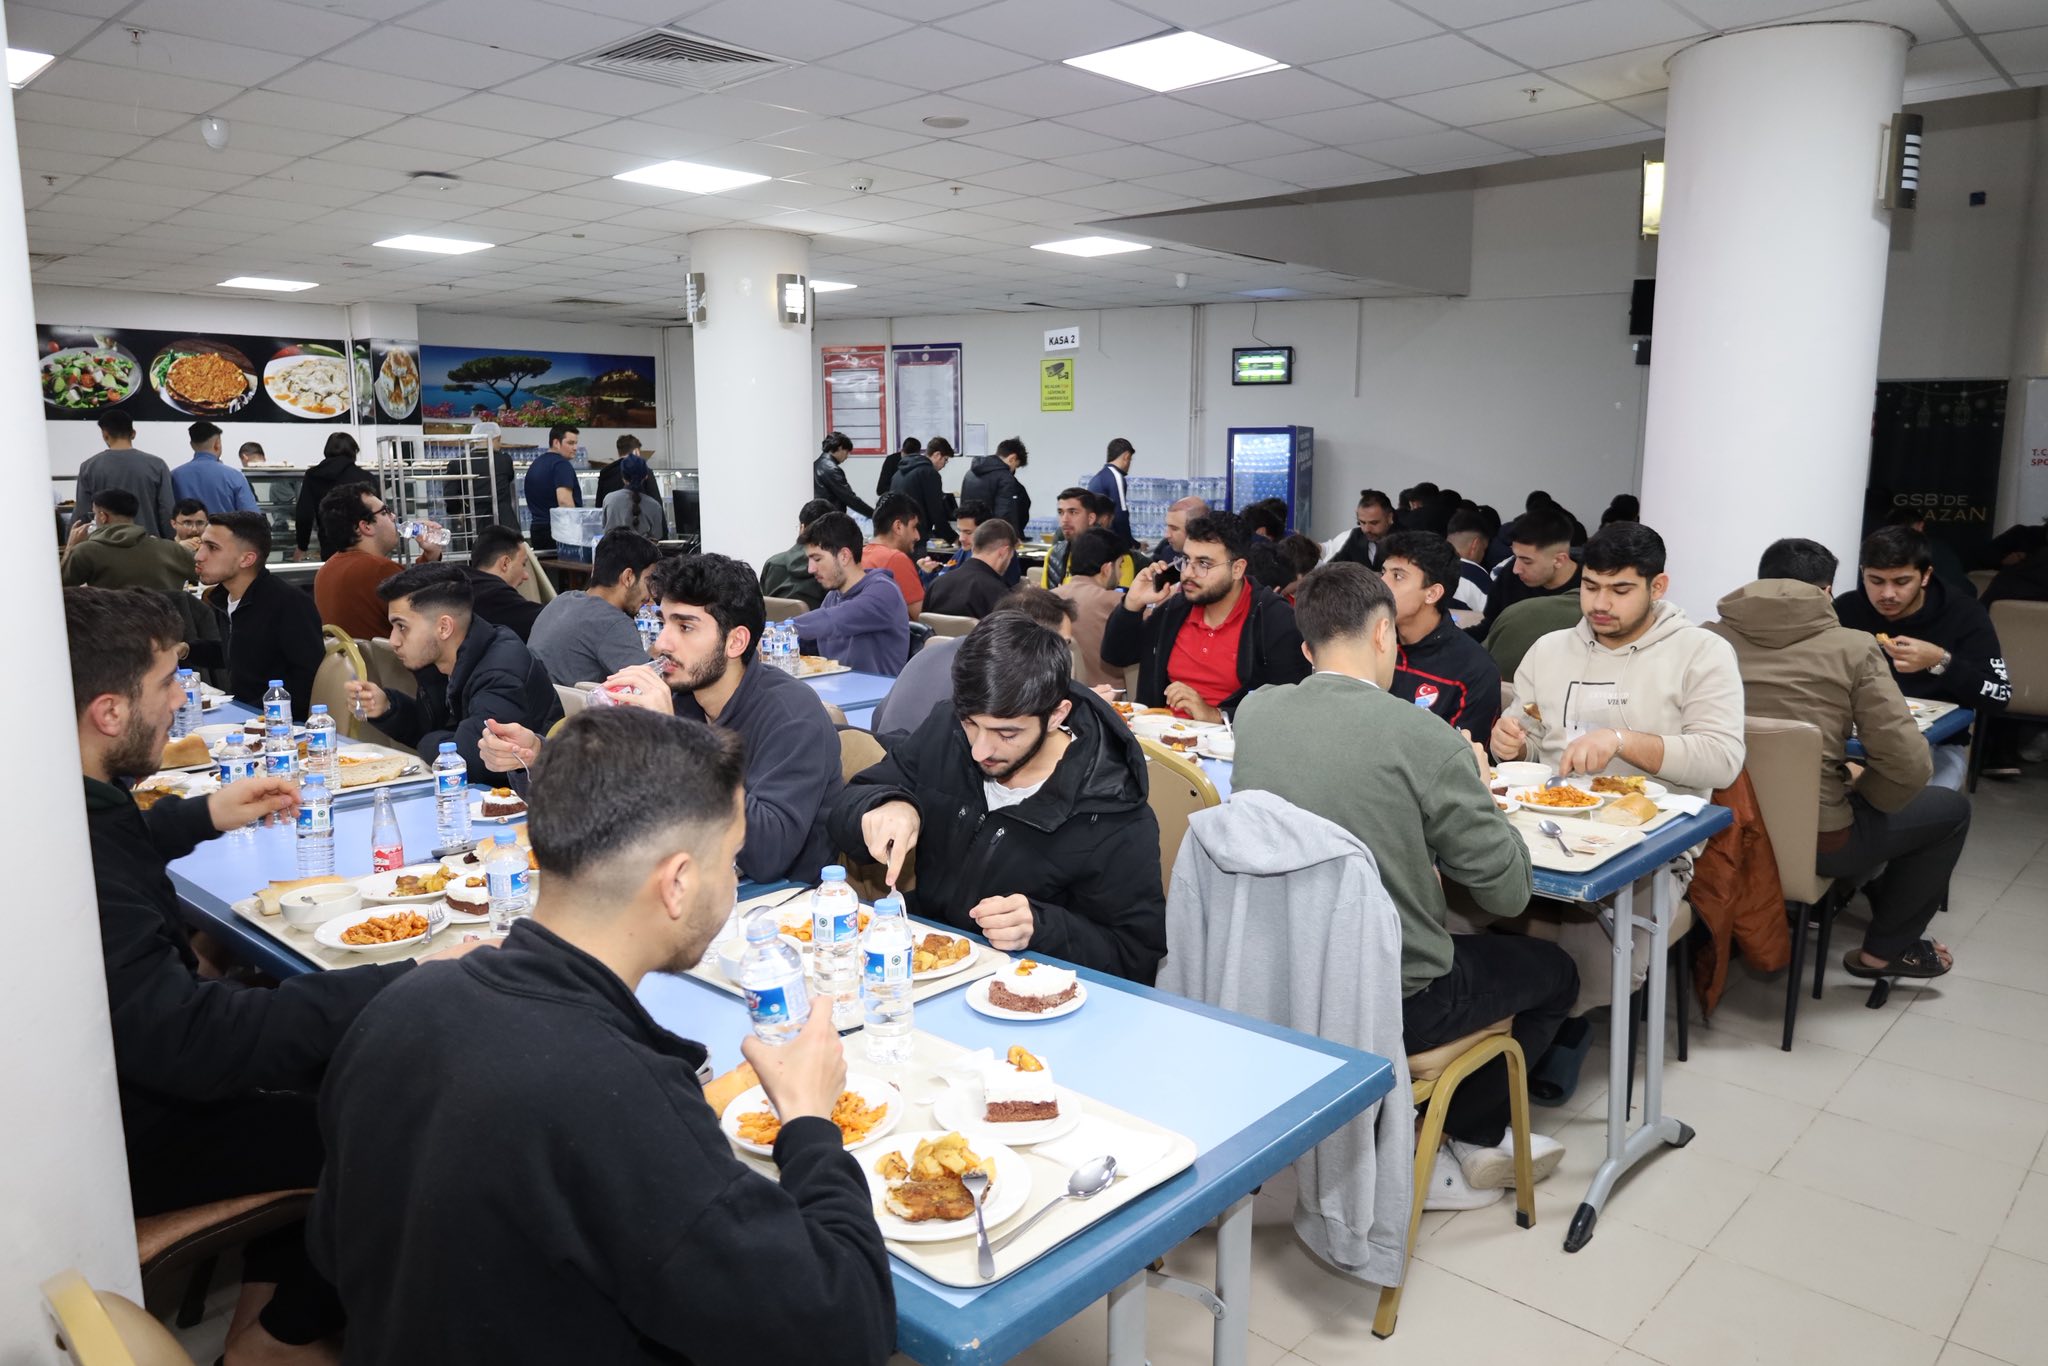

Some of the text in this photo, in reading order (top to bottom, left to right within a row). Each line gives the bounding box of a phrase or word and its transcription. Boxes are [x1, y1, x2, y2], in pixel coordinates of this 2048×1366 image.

[1048, 334, 1075, 346] KASA 2
[1893, 493, 1969, 507] GSB'DE
